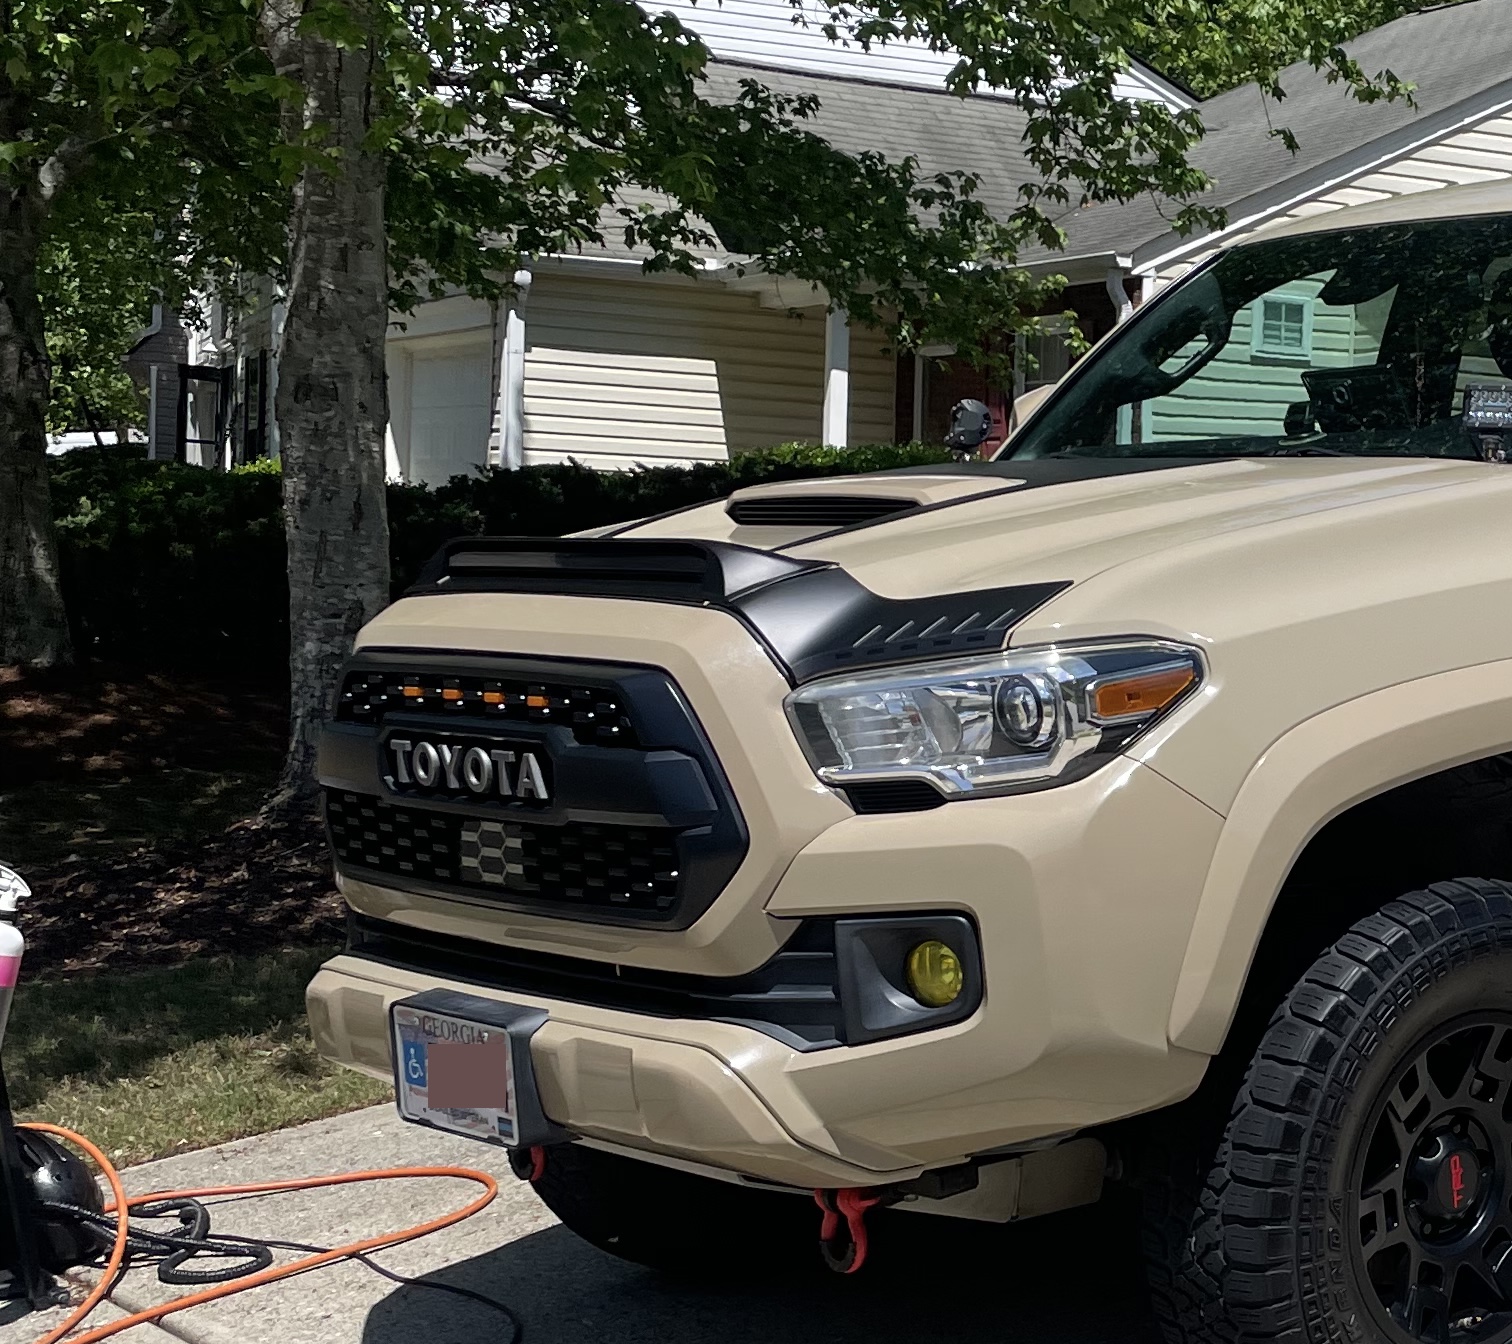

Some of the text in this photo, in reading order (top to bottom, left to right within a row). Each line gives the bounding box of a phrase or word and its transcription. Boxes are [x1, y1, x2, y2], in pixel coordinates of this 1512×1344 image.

[390, 739, 549, 799] TOYOTA
[422, 1015, 485, 1044] GEORGIA
[1450, 1154, 1465, 1209] TRD
[1328, 1197, 1363, 1343] KENDA
